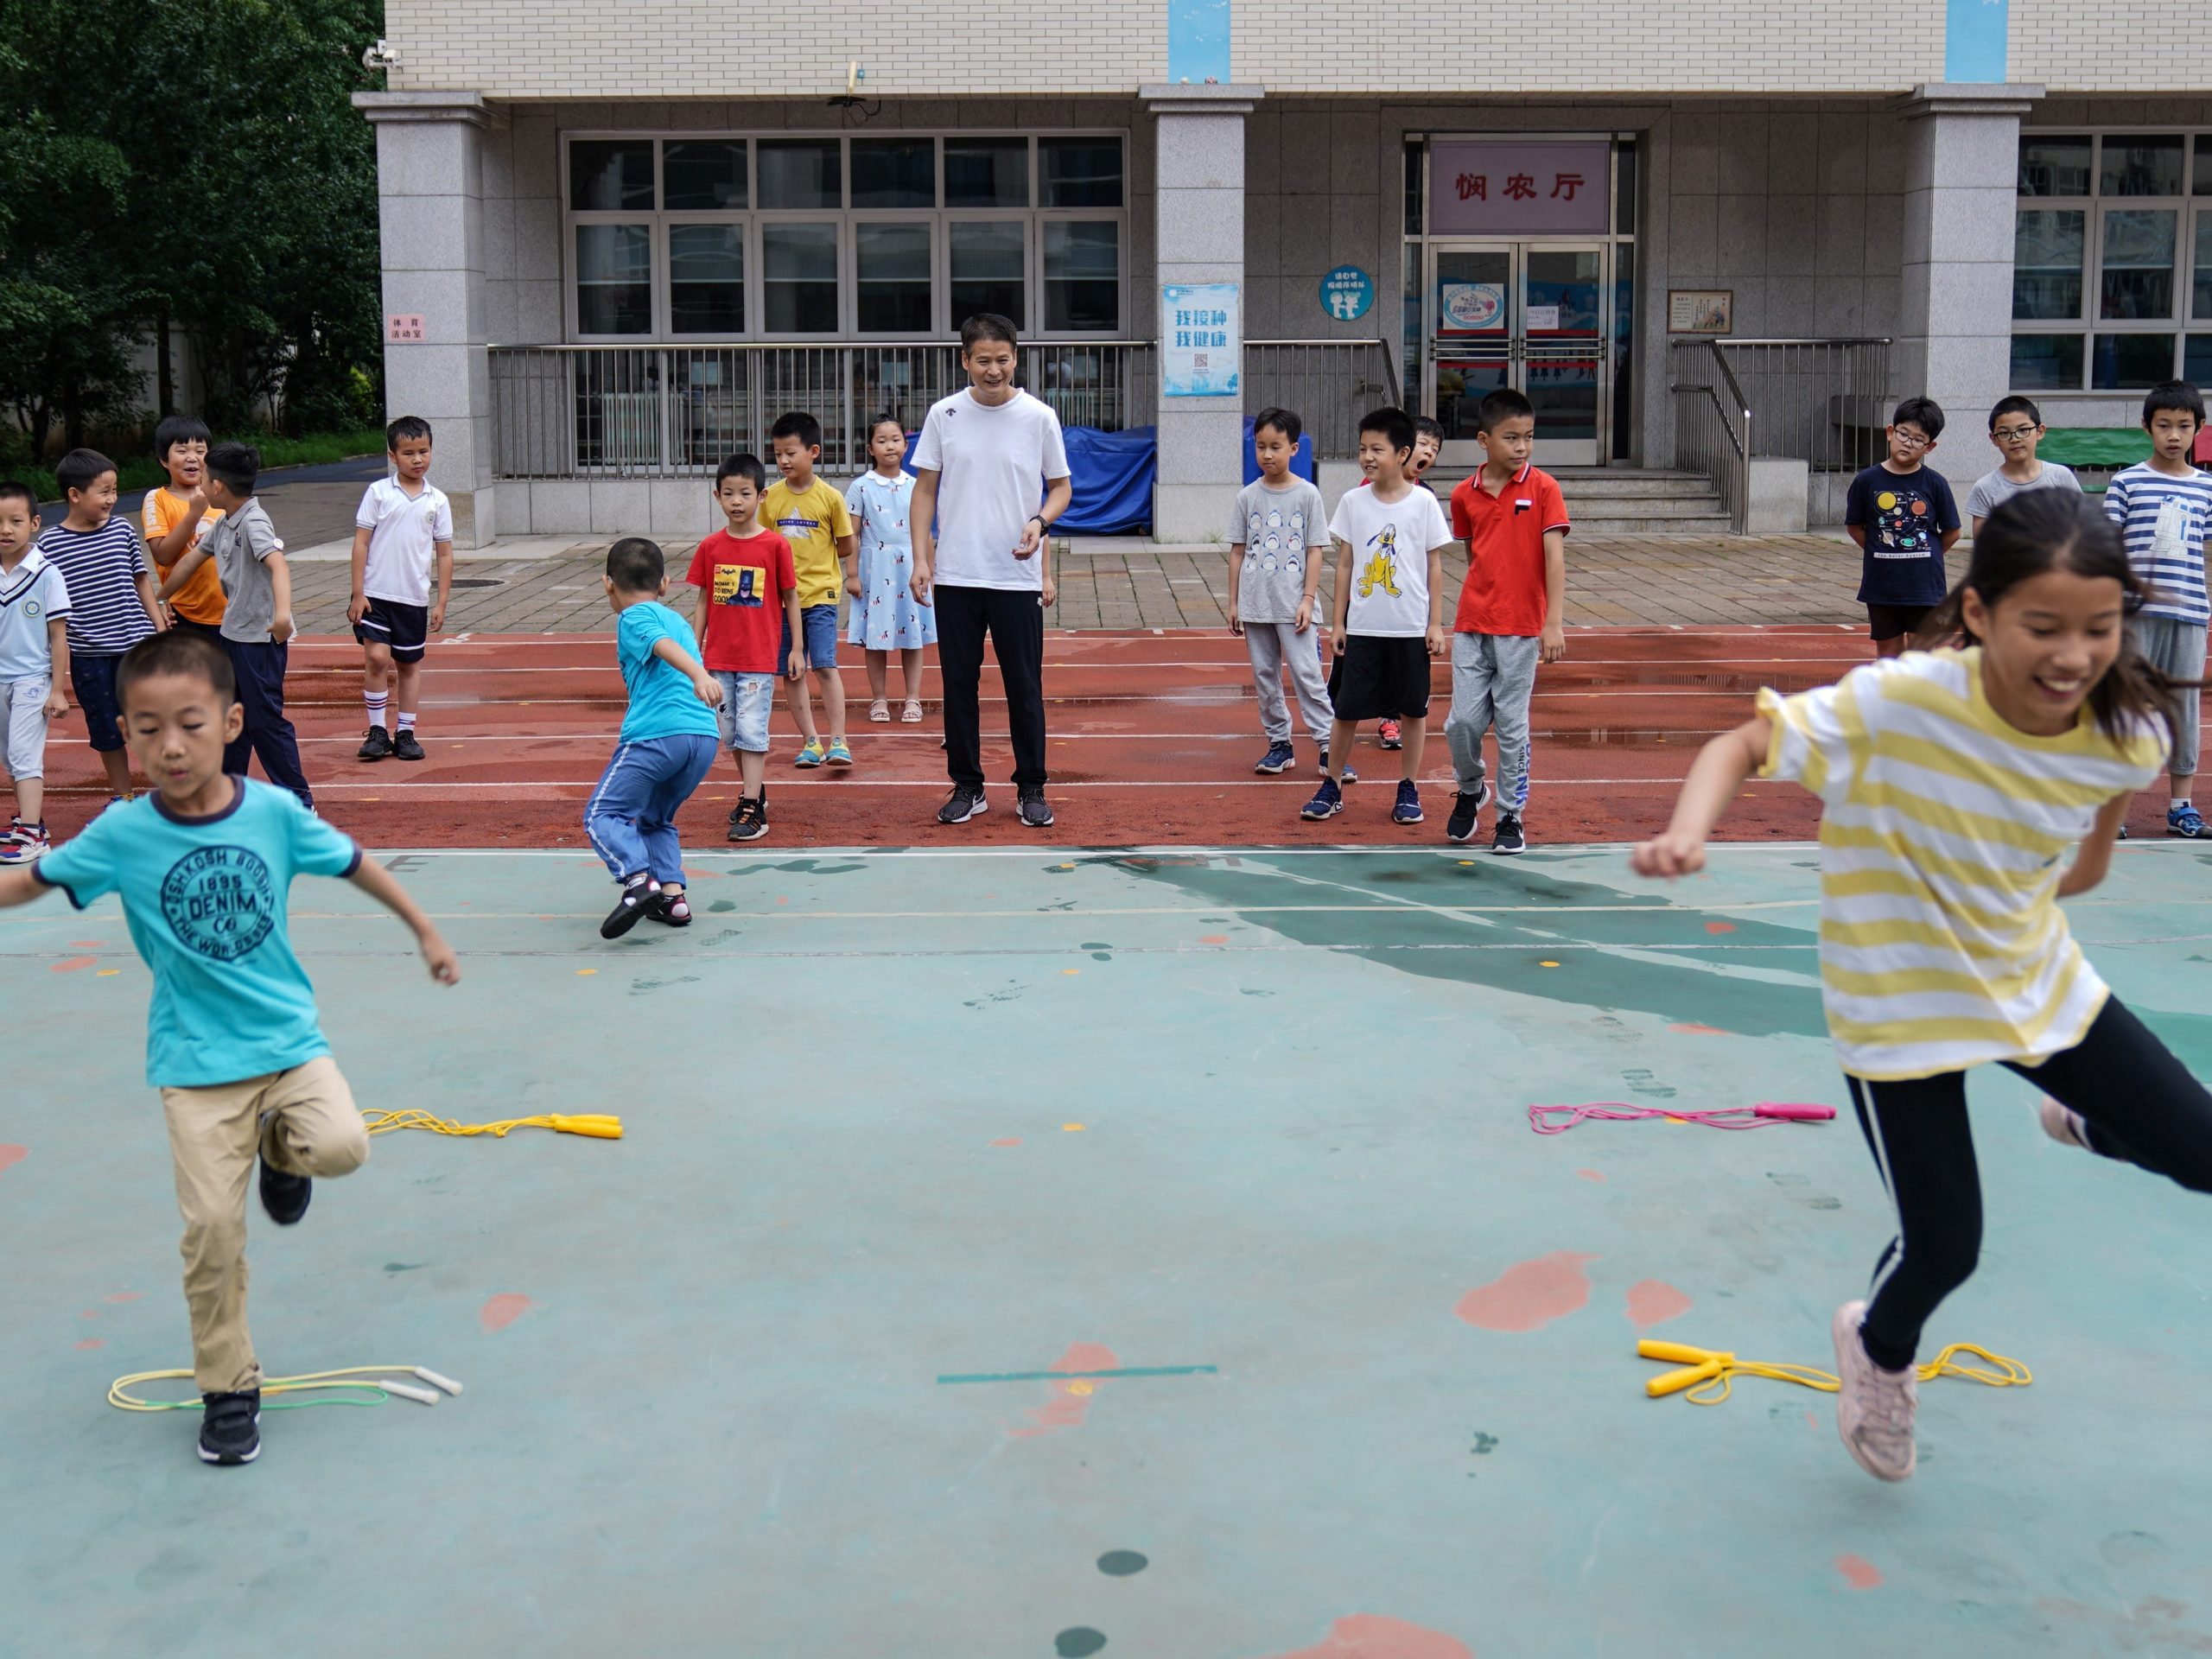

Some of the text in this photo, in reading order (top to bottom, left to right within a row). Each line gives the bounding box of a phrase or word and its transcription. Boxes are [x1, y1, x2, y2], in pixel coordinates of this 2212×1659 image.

[1455, 172, 1586, 201] 悯农厅
[1175, 309, 1227, 326] 我接种
[391, 329, 421, 338] 活动室
[1175, 331, 1227, 346] 我健康
[166, 849, 227, 904] OSHKOSH
[200, 874, 243, 893] 1895
[188, 892, 257, 920] DENIM
[175, 916, 197, 941] THE
